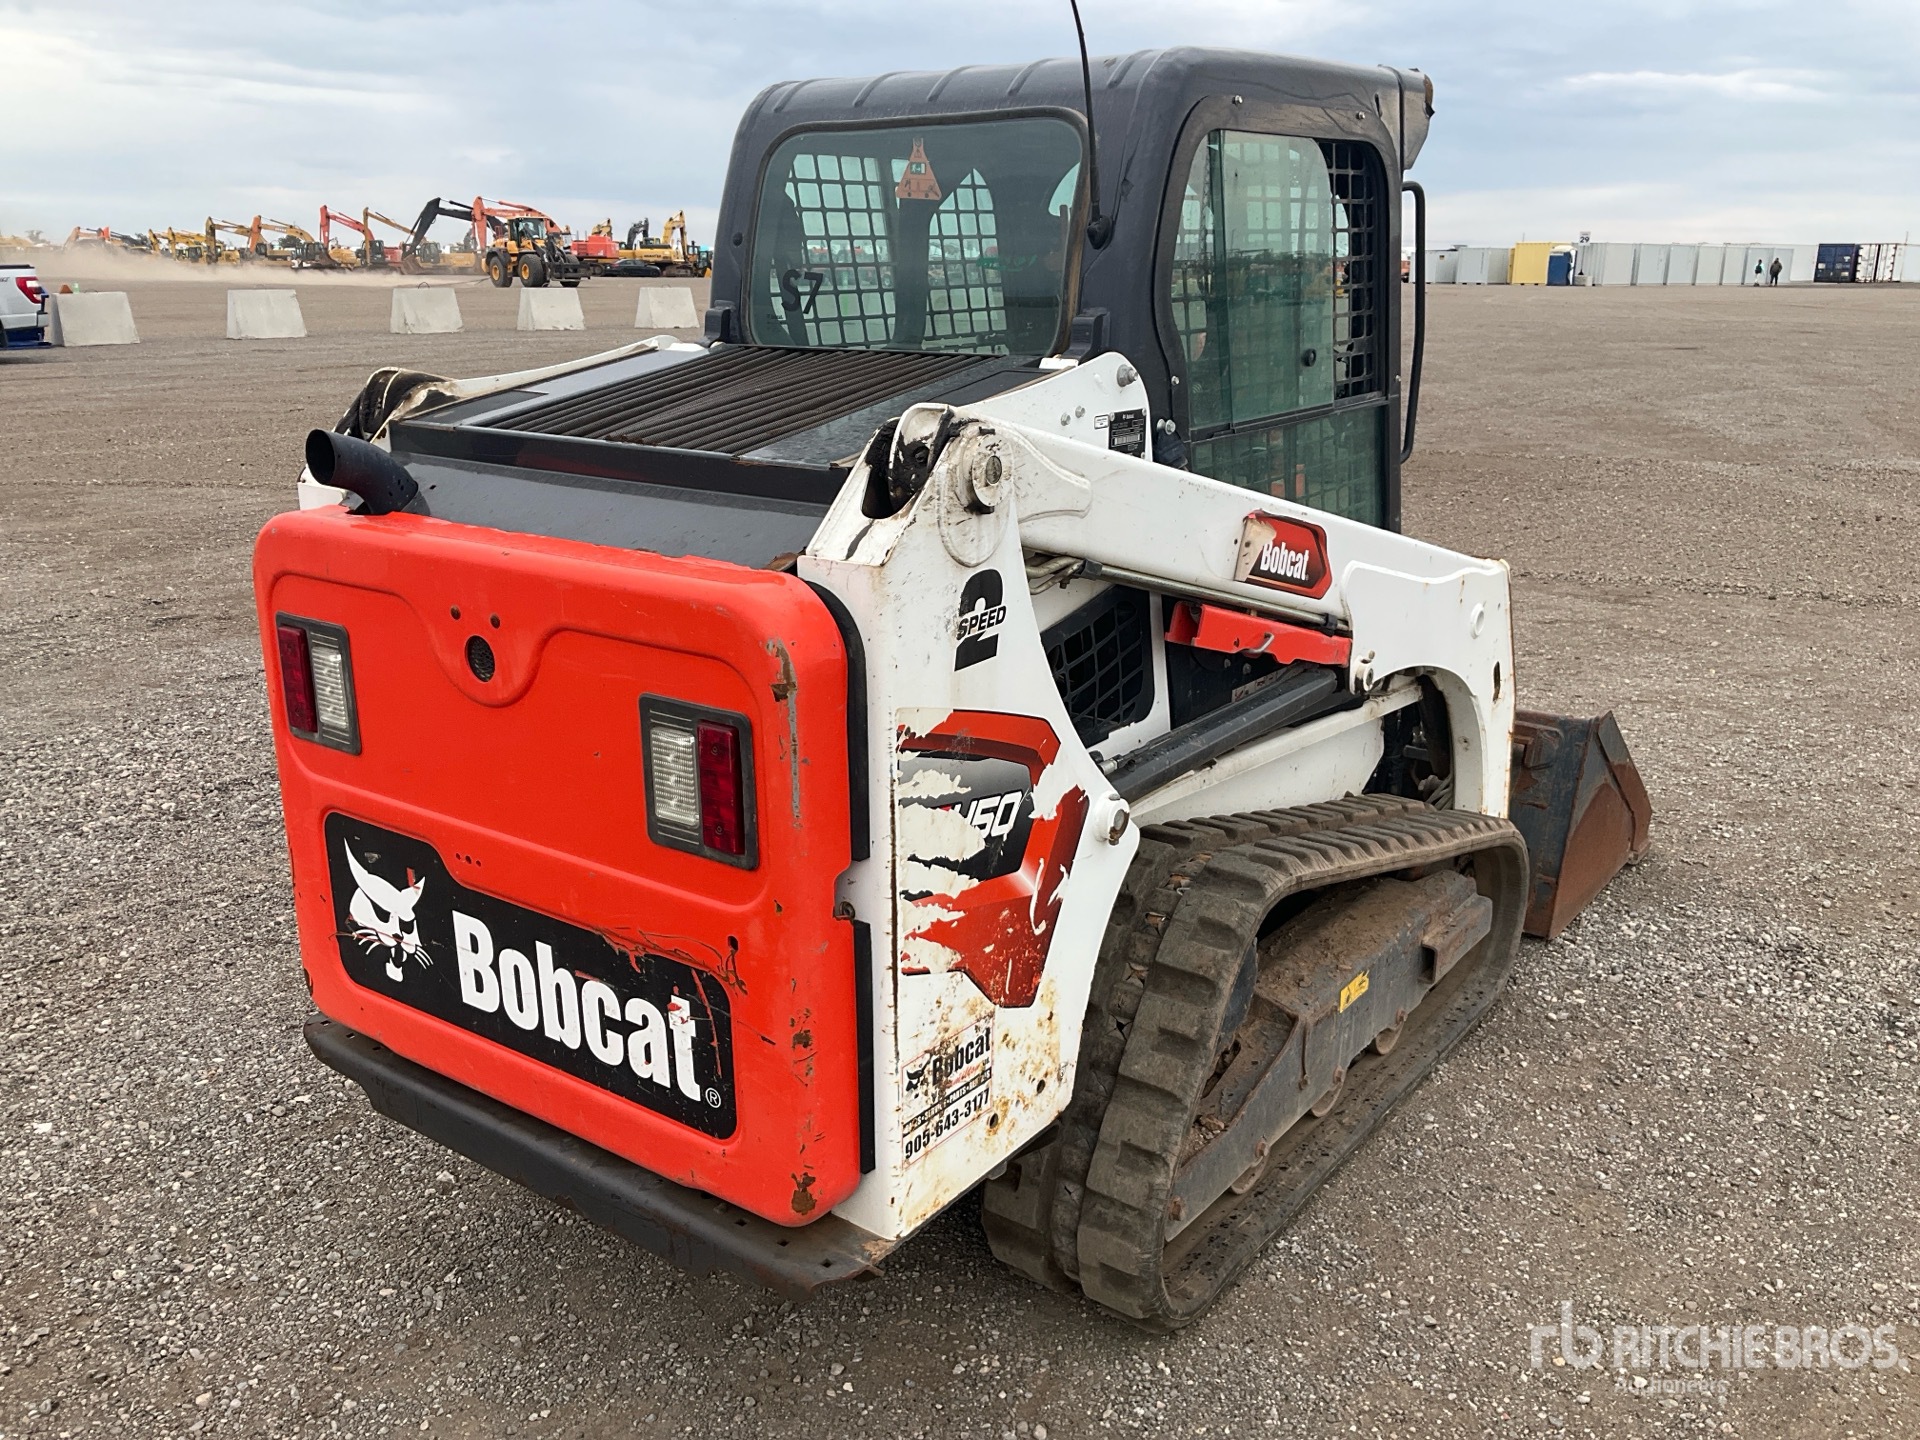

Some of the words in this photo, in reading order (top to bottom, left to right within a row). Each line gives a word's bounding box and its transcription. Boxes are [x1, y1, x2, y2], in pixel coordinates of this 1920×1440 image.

[1580, 236, 1590, 244] 29
[781, 269, 823, 314] S7
[1259, 539, 1310, 581] Bobcat
[956, 605, 1007, 641] SPEED
[452, 909, 701, 1102] Bobcat
[932, 1027, 991, 1086] Bobcat
[904, 1087, 990, 1159] 905-643-3177
